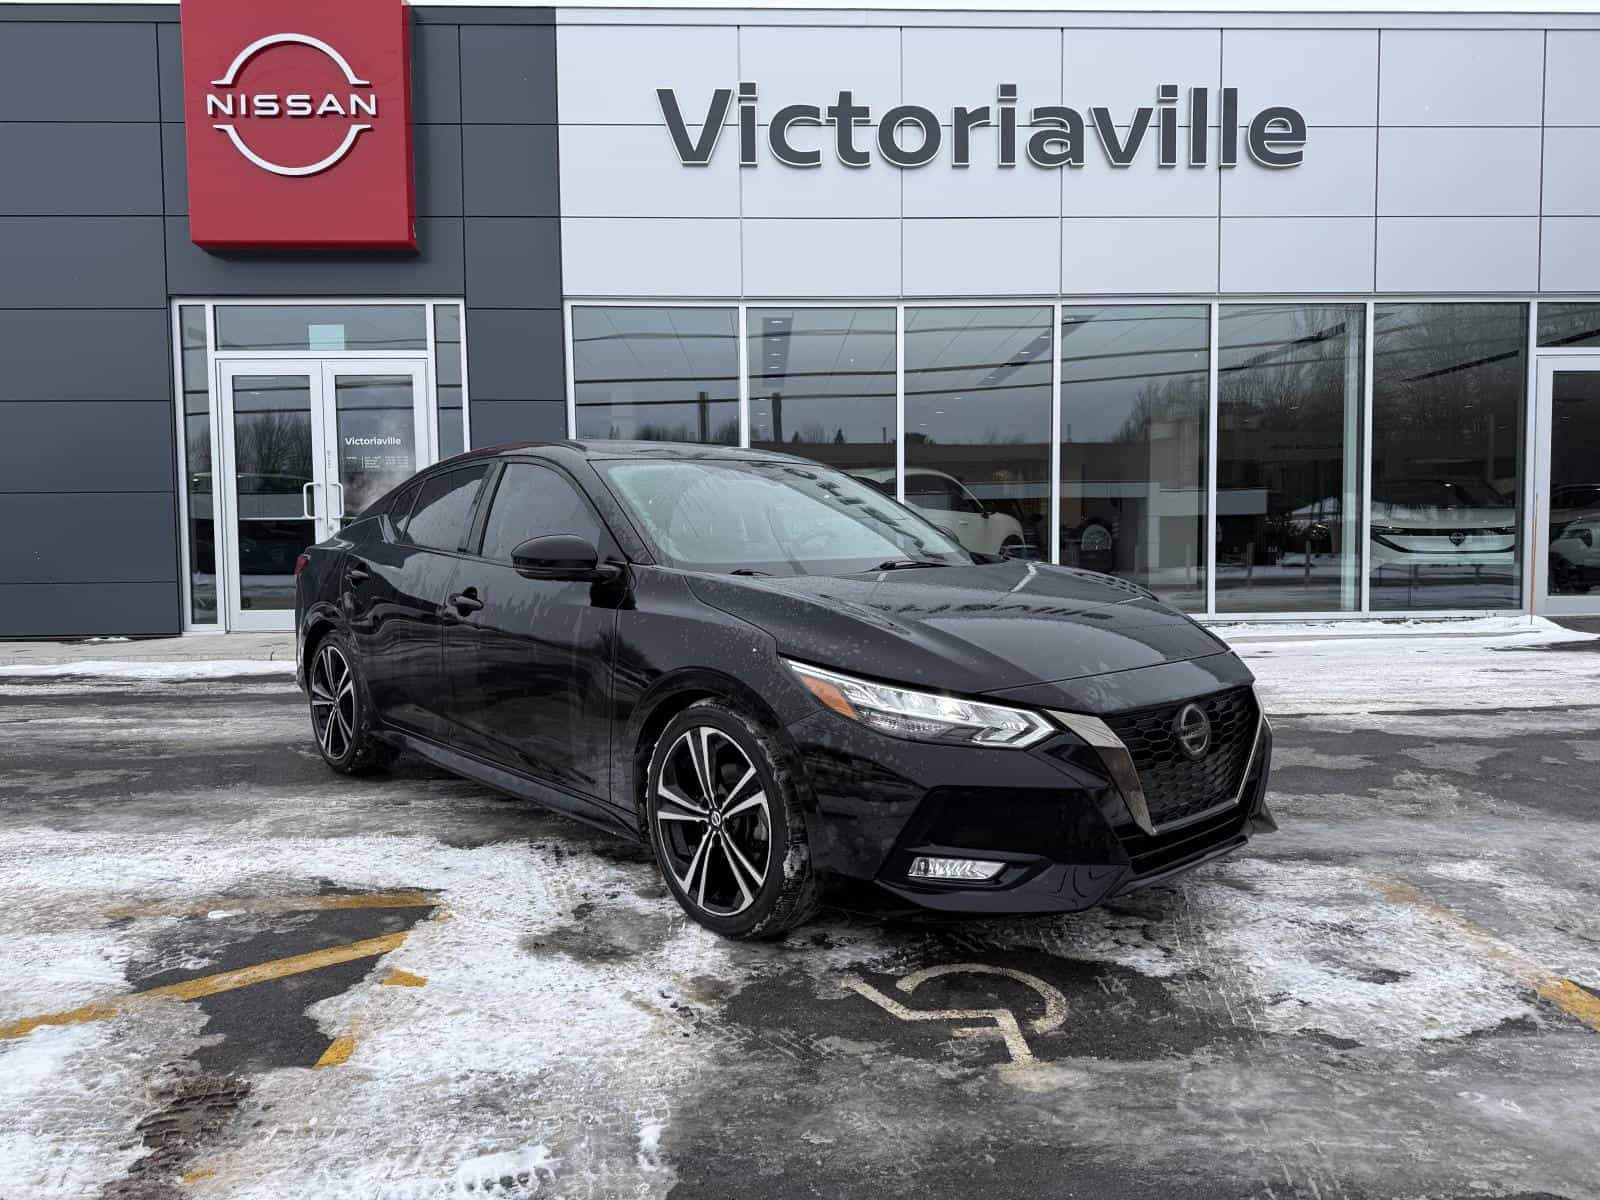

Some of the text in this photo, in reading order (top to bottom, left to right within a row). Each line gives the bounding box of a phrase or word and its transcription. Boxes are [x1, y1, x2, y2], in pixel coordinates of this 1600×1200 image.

[206, 93, 377, 116] NISSAN
[654, 80, 1307, 168] Victoriaville
[344, 436, 401, 446] Victoriaville
